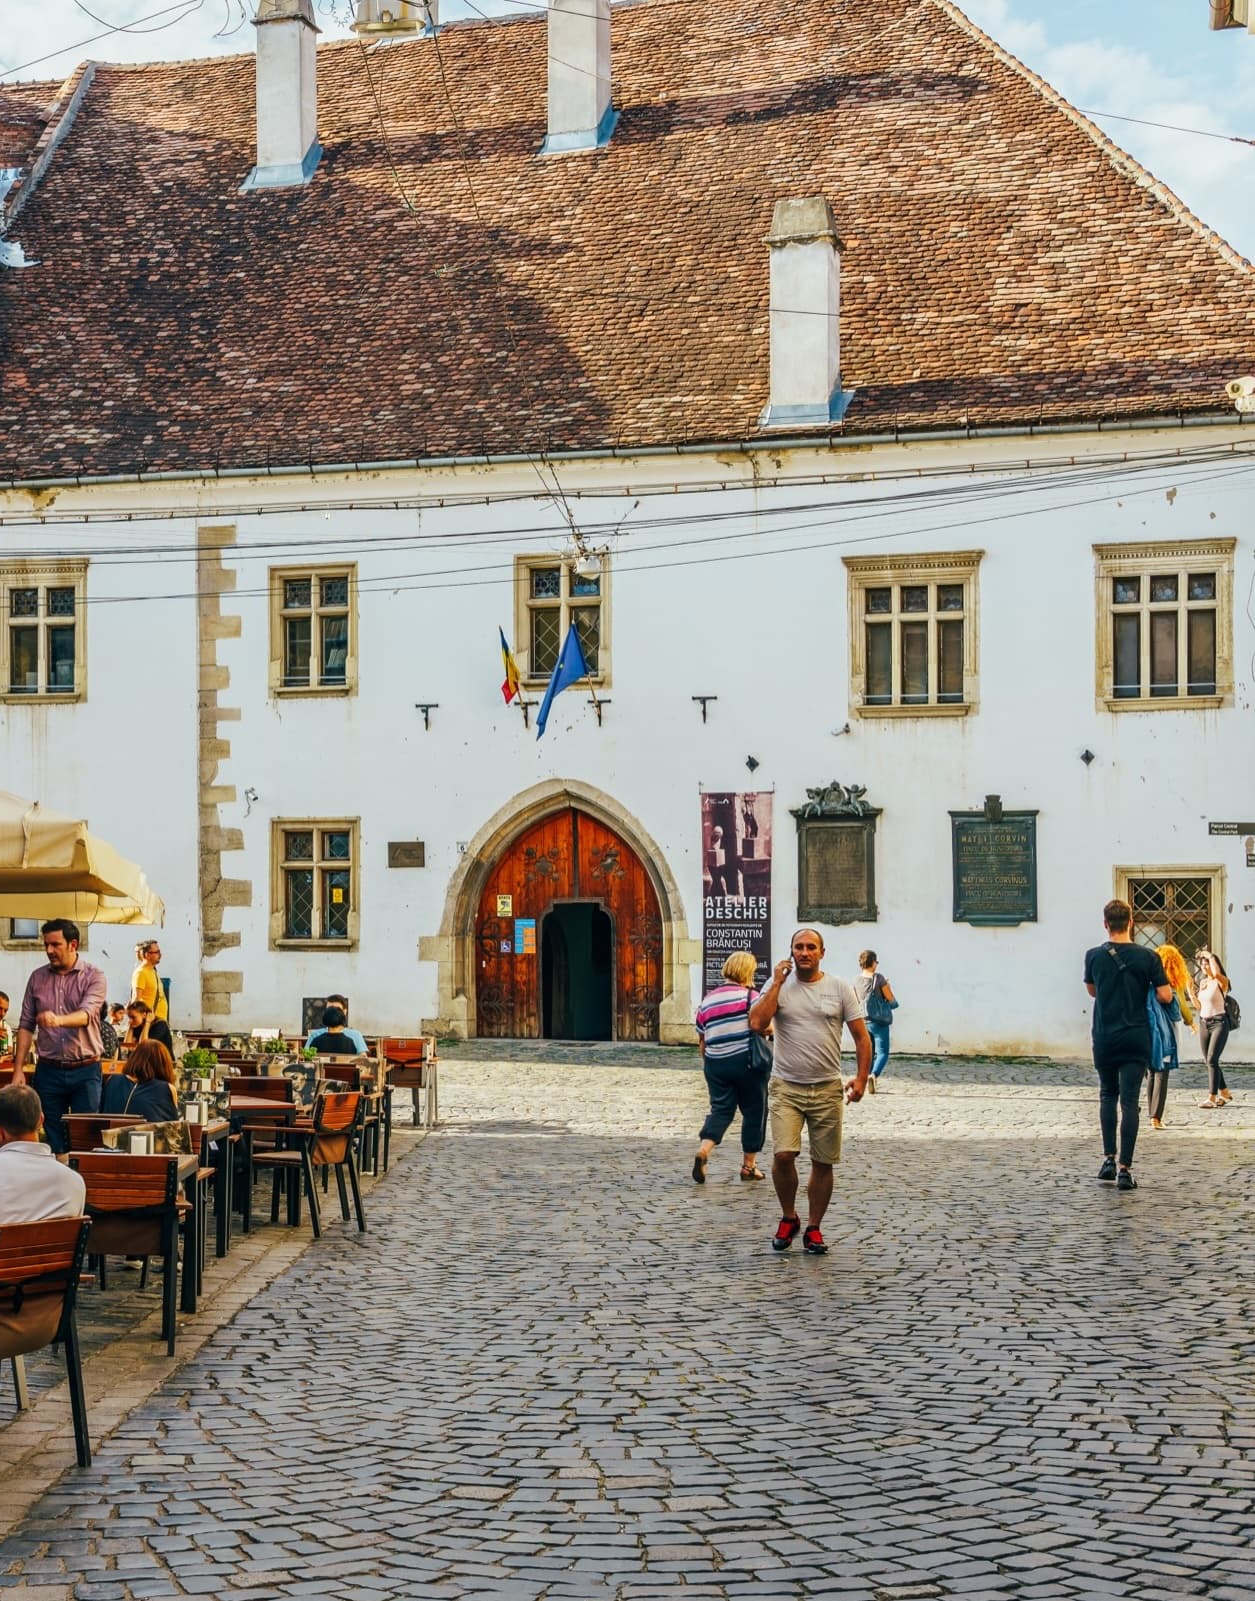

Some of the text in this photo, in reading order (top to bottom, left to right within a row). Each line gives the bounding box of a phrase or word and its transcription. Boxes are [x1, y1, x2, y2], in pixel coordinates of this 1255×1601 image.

[705, 896, 767, 908] ATELIER
[705, 908, 768, 919] DESCHIS
[706, 929, 763, 938] CONSTANTIN
